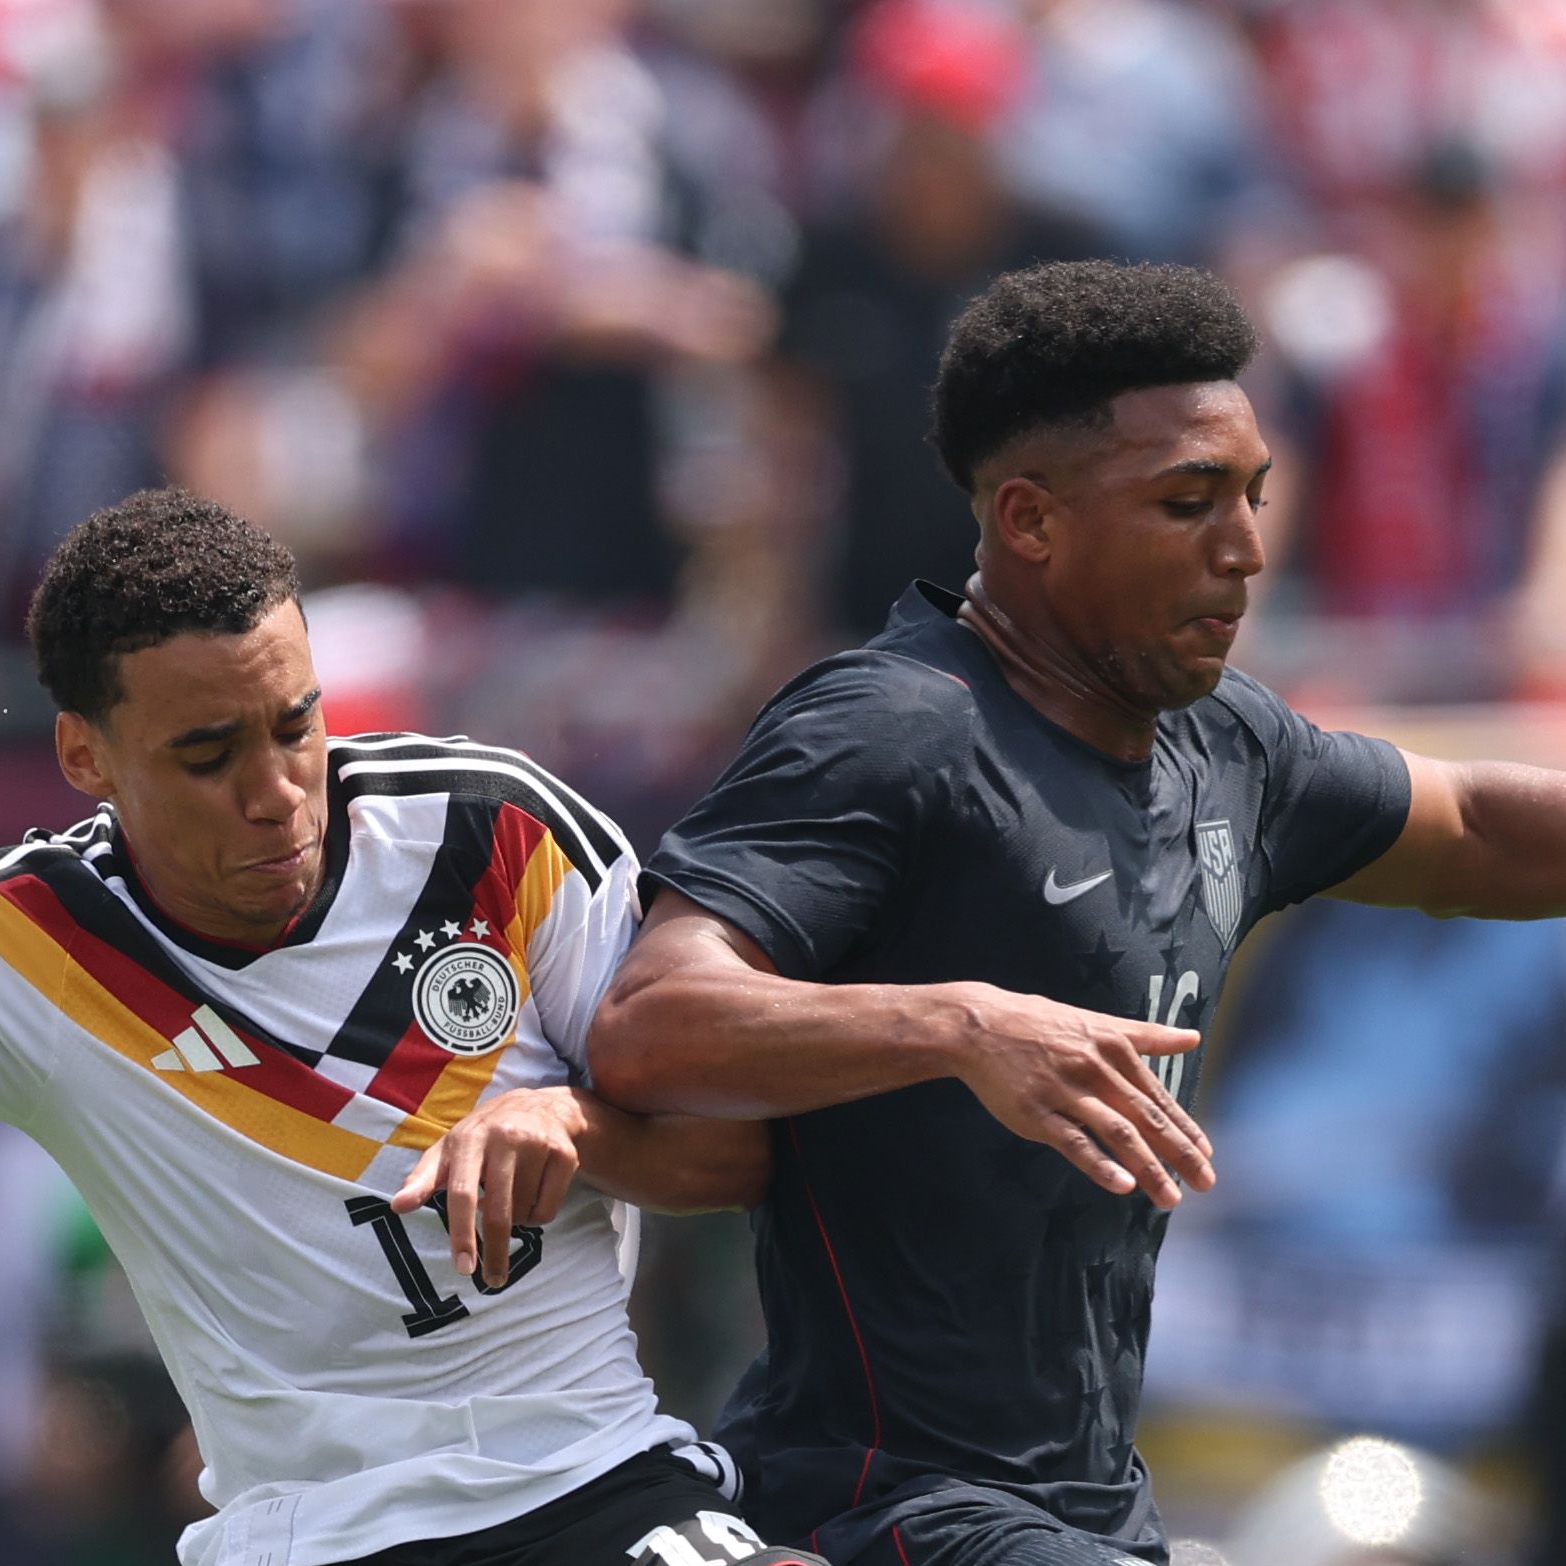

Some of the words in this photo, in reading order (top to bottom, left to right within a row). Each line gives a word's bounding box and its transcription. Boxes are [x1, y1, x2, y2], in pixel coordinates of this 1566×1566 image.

[1198, 828, 1233, 877] USA
[431, 960, 485, 992] DEUTSCHER
[443, 995, 506, 1039] FUSSBALL-BUND
